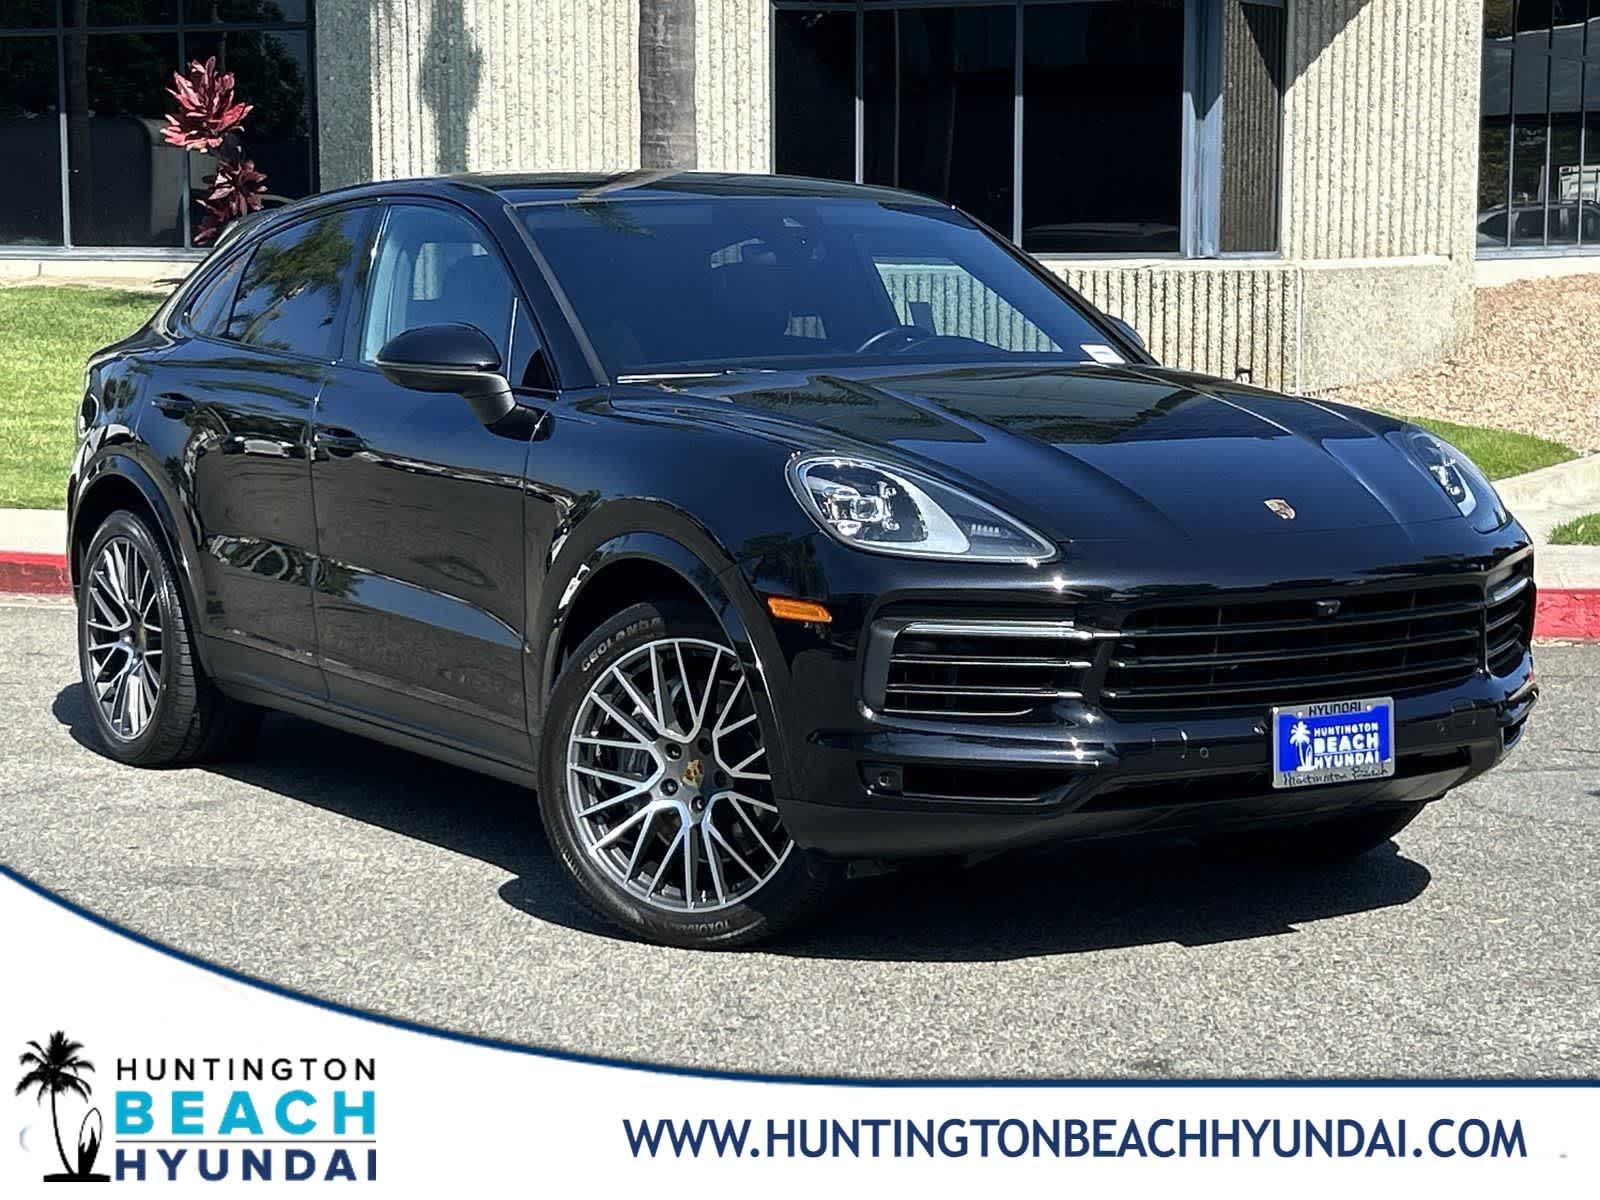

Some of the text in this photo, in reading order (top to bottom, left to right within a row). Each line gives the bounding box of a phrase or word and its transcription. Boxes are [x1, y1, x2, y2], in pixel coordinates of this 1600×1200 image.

[1308, 702, 1361, 717] HYUNDAI
[1313, 722, 1379, 737] HUNTINGTON
[1314, 733, 1379, 754] BEACH
[1314, 751, 1379, 770] HYUNDAI
